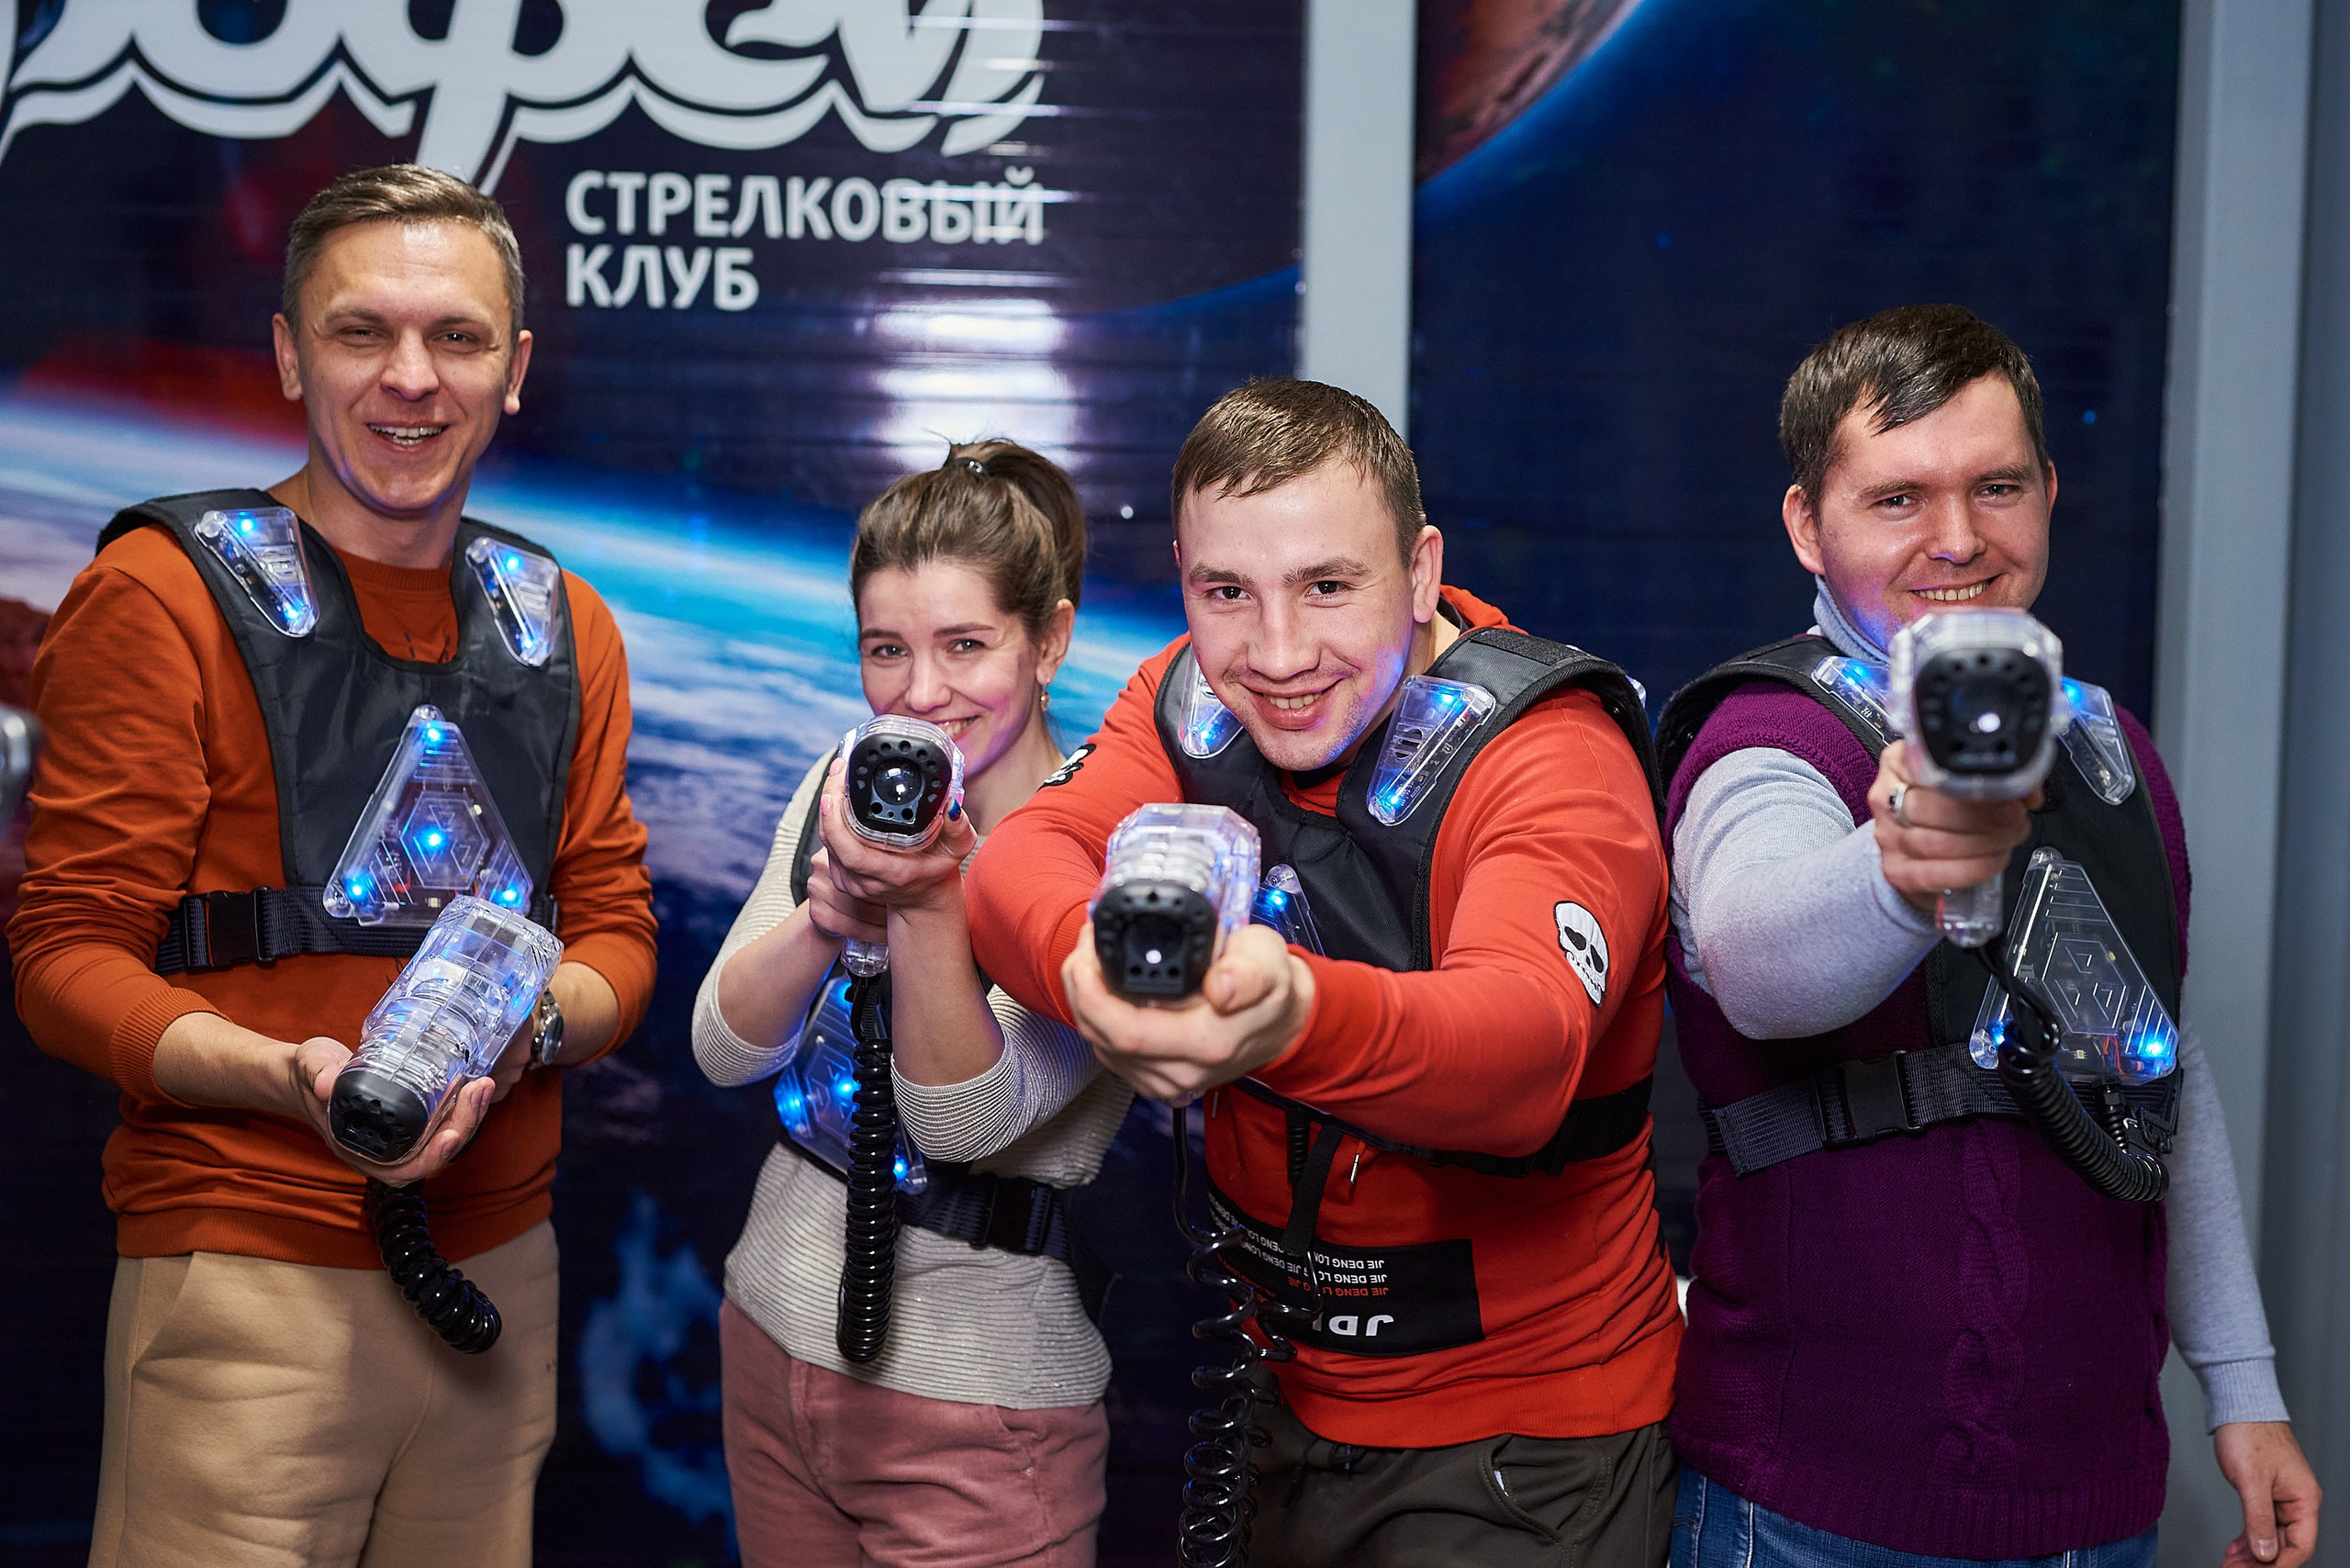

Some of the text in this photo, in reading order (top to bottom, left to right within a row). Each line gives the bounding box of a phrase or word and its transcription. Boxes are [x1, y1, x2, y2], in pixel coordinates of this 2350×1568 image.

[565, 165, 1045, 246] СТРЕЛКОВЫЙ
[565, 242, 760, 310] КЛУБ
[1287, 1261, 1302, 1274] JIE
[1332, 1258, 1365, 1269] DENG
[1366, 1260, 1385, 1269] JIE
[1334, 1273, 1367, 1283] DENG
[1369, 1274, 1388, 1283] JIE
[1335, 1287, 1369, 1296] DENG
[1371, 1287, 1389, 1295] JIE
